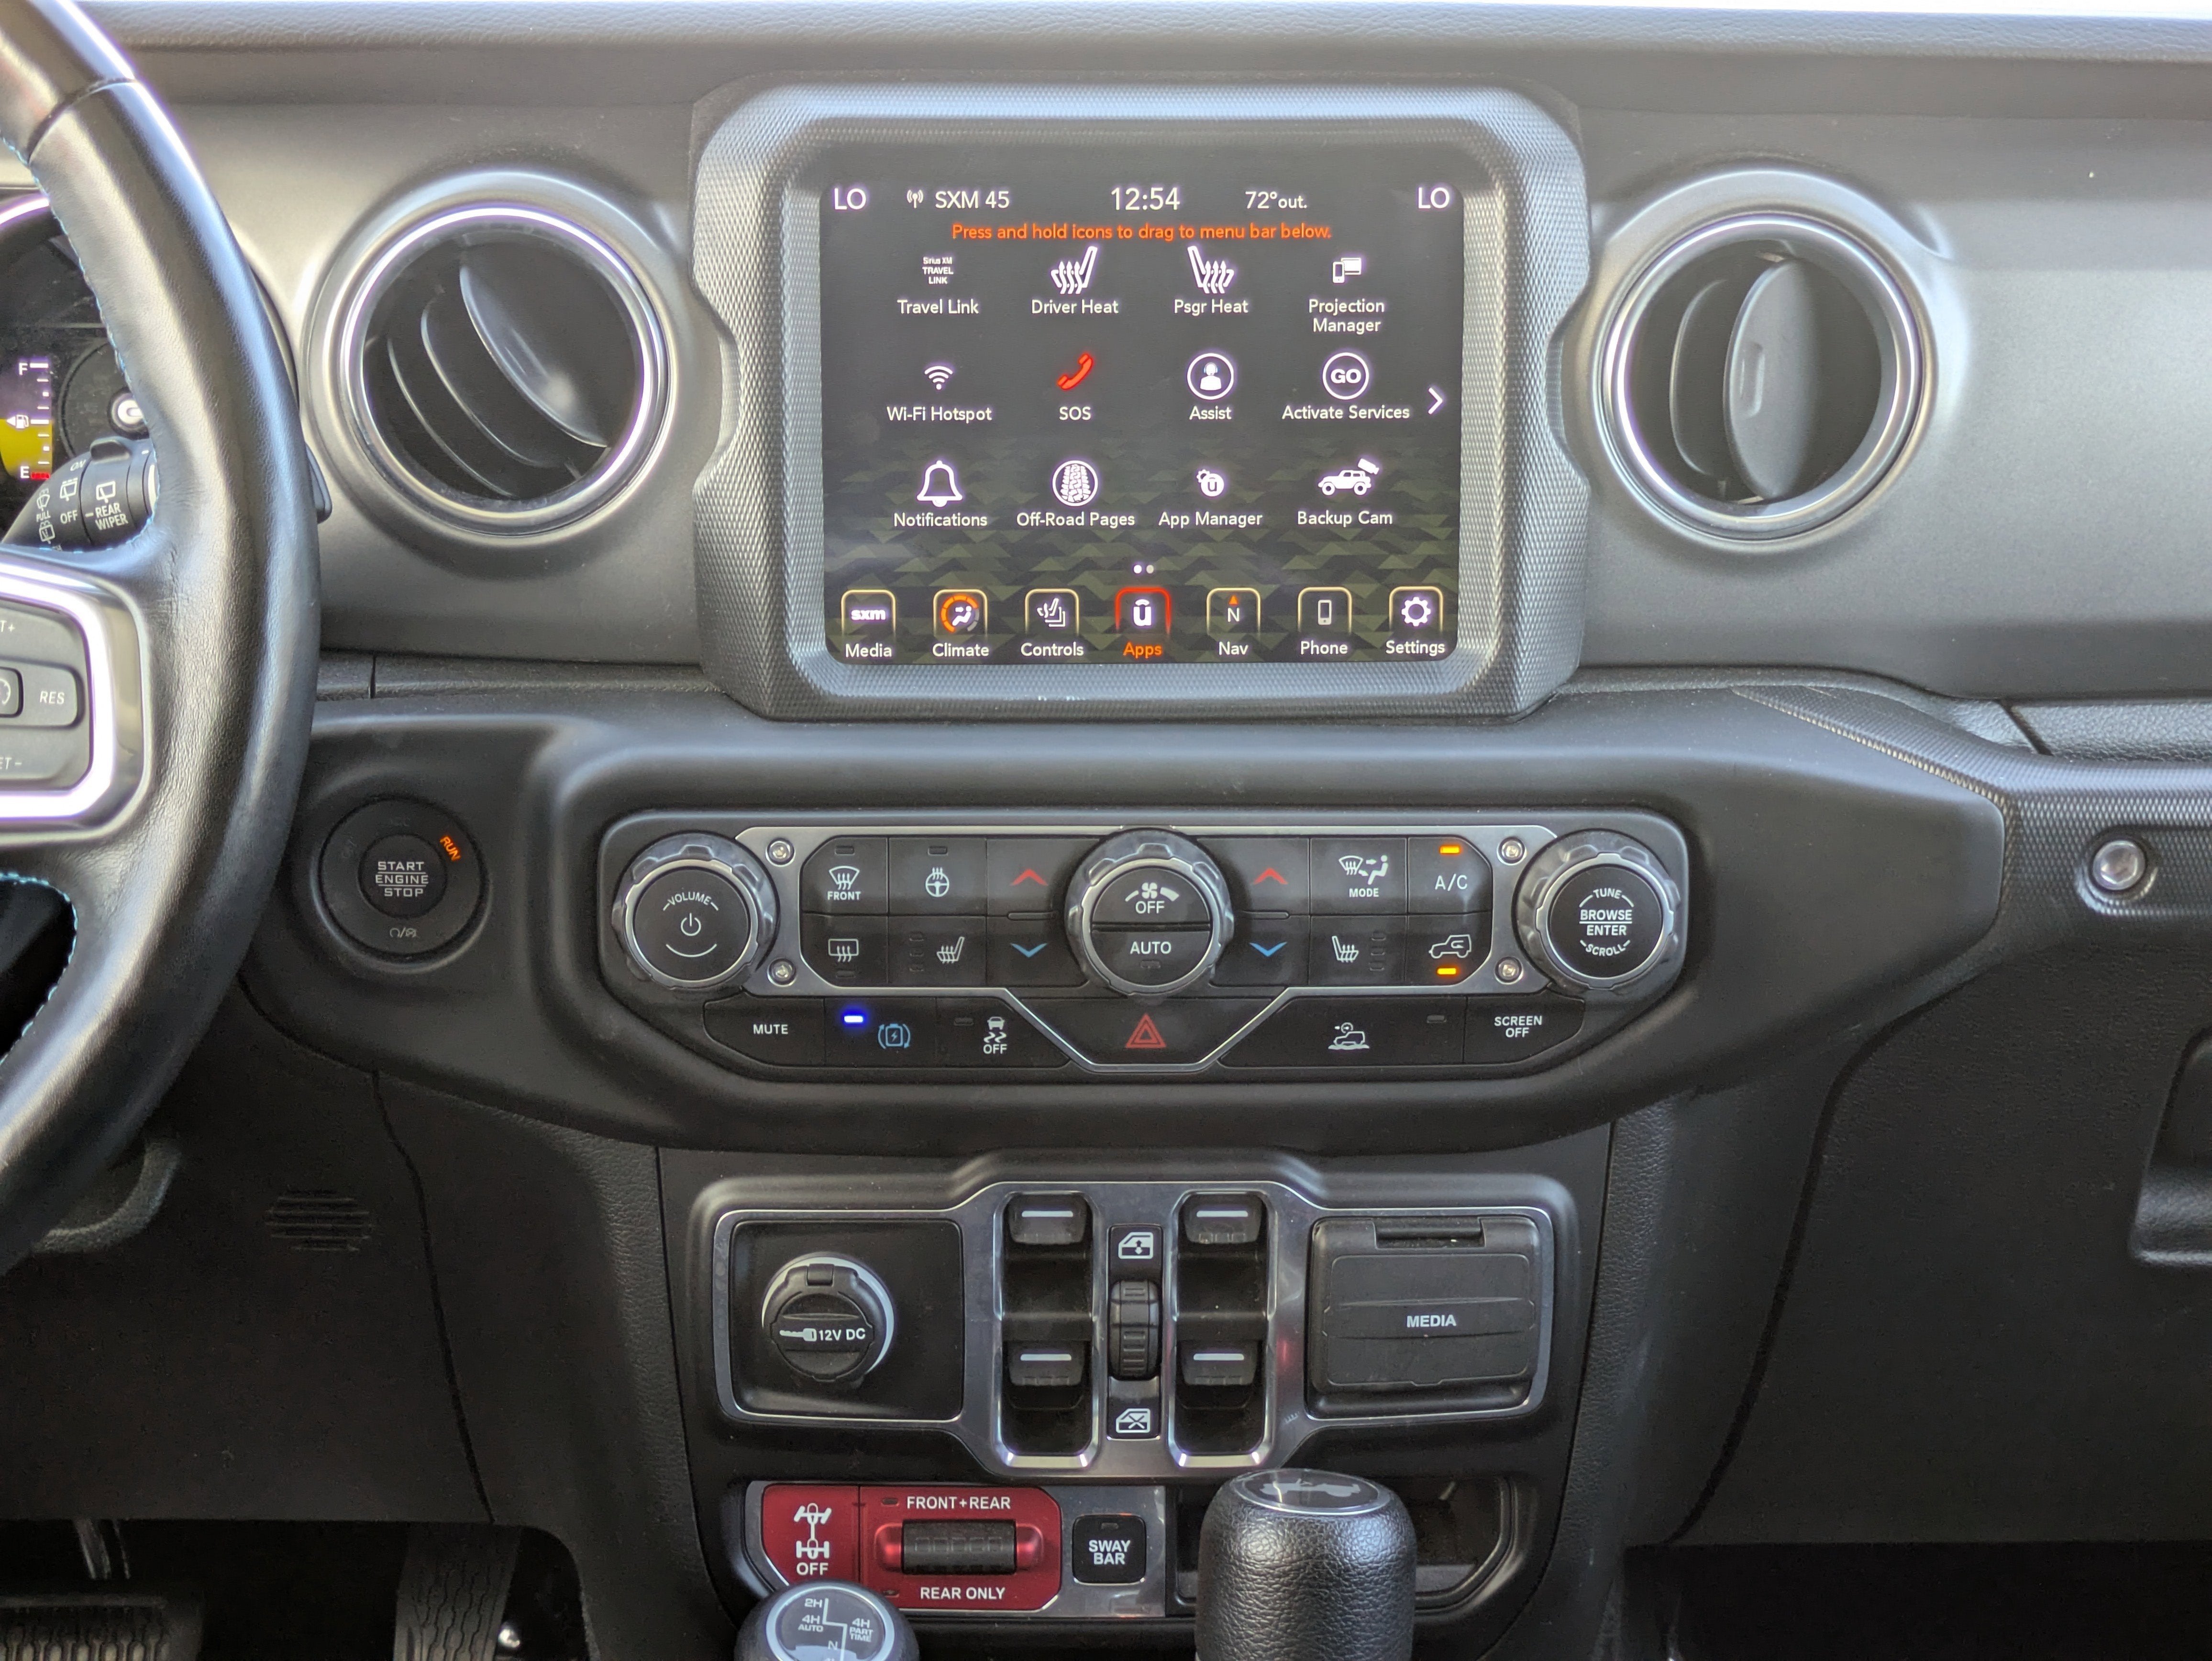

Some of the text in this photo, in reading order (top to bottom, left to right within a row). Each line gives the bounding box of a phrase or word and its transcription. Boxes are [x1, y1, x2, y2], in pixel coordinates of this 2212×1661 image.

[834, 188, 866, 210] LO
[935, 191, 1010, 209] SXM 45
[1111, 187, 1180, 210] 12:54
[1418, 188, 1450, 209] LO
[952, 223, 1331, 241] Press and hold icons to drag to menu bar below.
[898, 299, 978, 314] Travel Link
[1032, 300, 1118, 314] Driver Heat
[1174, 300, 1248, 315] Psgr Heat
[1309, 299, 1384, 315] Projection
[1314, 319, 1381, 334] Manager
[19, 363, 28, 375] F
[1331, 369, 1361, 383] GO
[887, 407, 992, 423] Wi-Fi Hotspot
[1060, 407, 1091, 421] SOS
[1189, 406, 1232, 420] Assist
[1282, 406, 1409, 419] Activate Services
[21, 466, 29, 478] E
[70, 460, 86, 471] ON
[36, 510, 51, 522] PULL
[60, 510, 78, 524] OFF
[95, 503, 121, 518] REAR
[95, 514, 128, 530] WIPER
[894, 513, 987, 526] Notifications
[1017, 512, 1135, 529] Off-Road Pages
[1159, 512, 1262, 528] App Manager
[1297, 511, 1392, 527] Backup Cam
[851, 609, 886, 620] sxm
[1228, 608, 1239, 622] N
[845, 644, 892, 658] Media
[932, 643, 989, 657] Climate
[1021, 642, 1084, 656] Controls
[1123, 643, 1162, 658] Apps
[1219, 642, 1249, 655] Nav
[1301, 641, 1348, 654] Phone
[1385, 641, 1445, 656] Settings
[40, 691, 65, 705] RES
[440, 835, 461, 861] RUN
[378, 862, 424, 871] START
[375, 875, 429, 884] ENGINE
[1435, 875, 1468, 891] A/C
[384, 888, 423, 897] STOP
[667, 892, 712, 906] VOLUME
[828, 891, 861, 901] FRONT
[1349, 888, 1379, 897] MODE
[1593, 889, 1622, 900] TUNE
[1135, 901, 1164, 914] OFF
[1580, 909, 1632, 921] BROWSE
[1587, 925, 1626, 936] ENTER
[1130, 941, 1171, 954] AUTO
[1585, 943, 1626, 957] SCROLL
[1494, 1016, 1542, 1027] SCREEN
[753, 1024, 788, 1034] MUTE
[1505, 1028, 1529, 1039] OFF
[984, 1044, 1007, 1054] OFF
[1407, 1315, 1456, 1328] MEDIA
[819, 1328, 865, 1341] 12V DC
[1089, 1540, 1130, 1552] SWAY
[1094, 1552, 1125, 1565] BAR
[796, 1562, 829, 1575] OFF
[920, 1587, 1005, 1599] REAR ONLY
[805, 1598, 822, 1608] 2H
[802, 1615, 820, 1624] 4H
[852, 1618, 870, 1628] 4H
[798, 1624, 823, 1632] AUTO
[850, 1627, 874, 1635] PART
[851, 1633, 871, 1642] TIME
[828, 1640, 838, 1650] N
